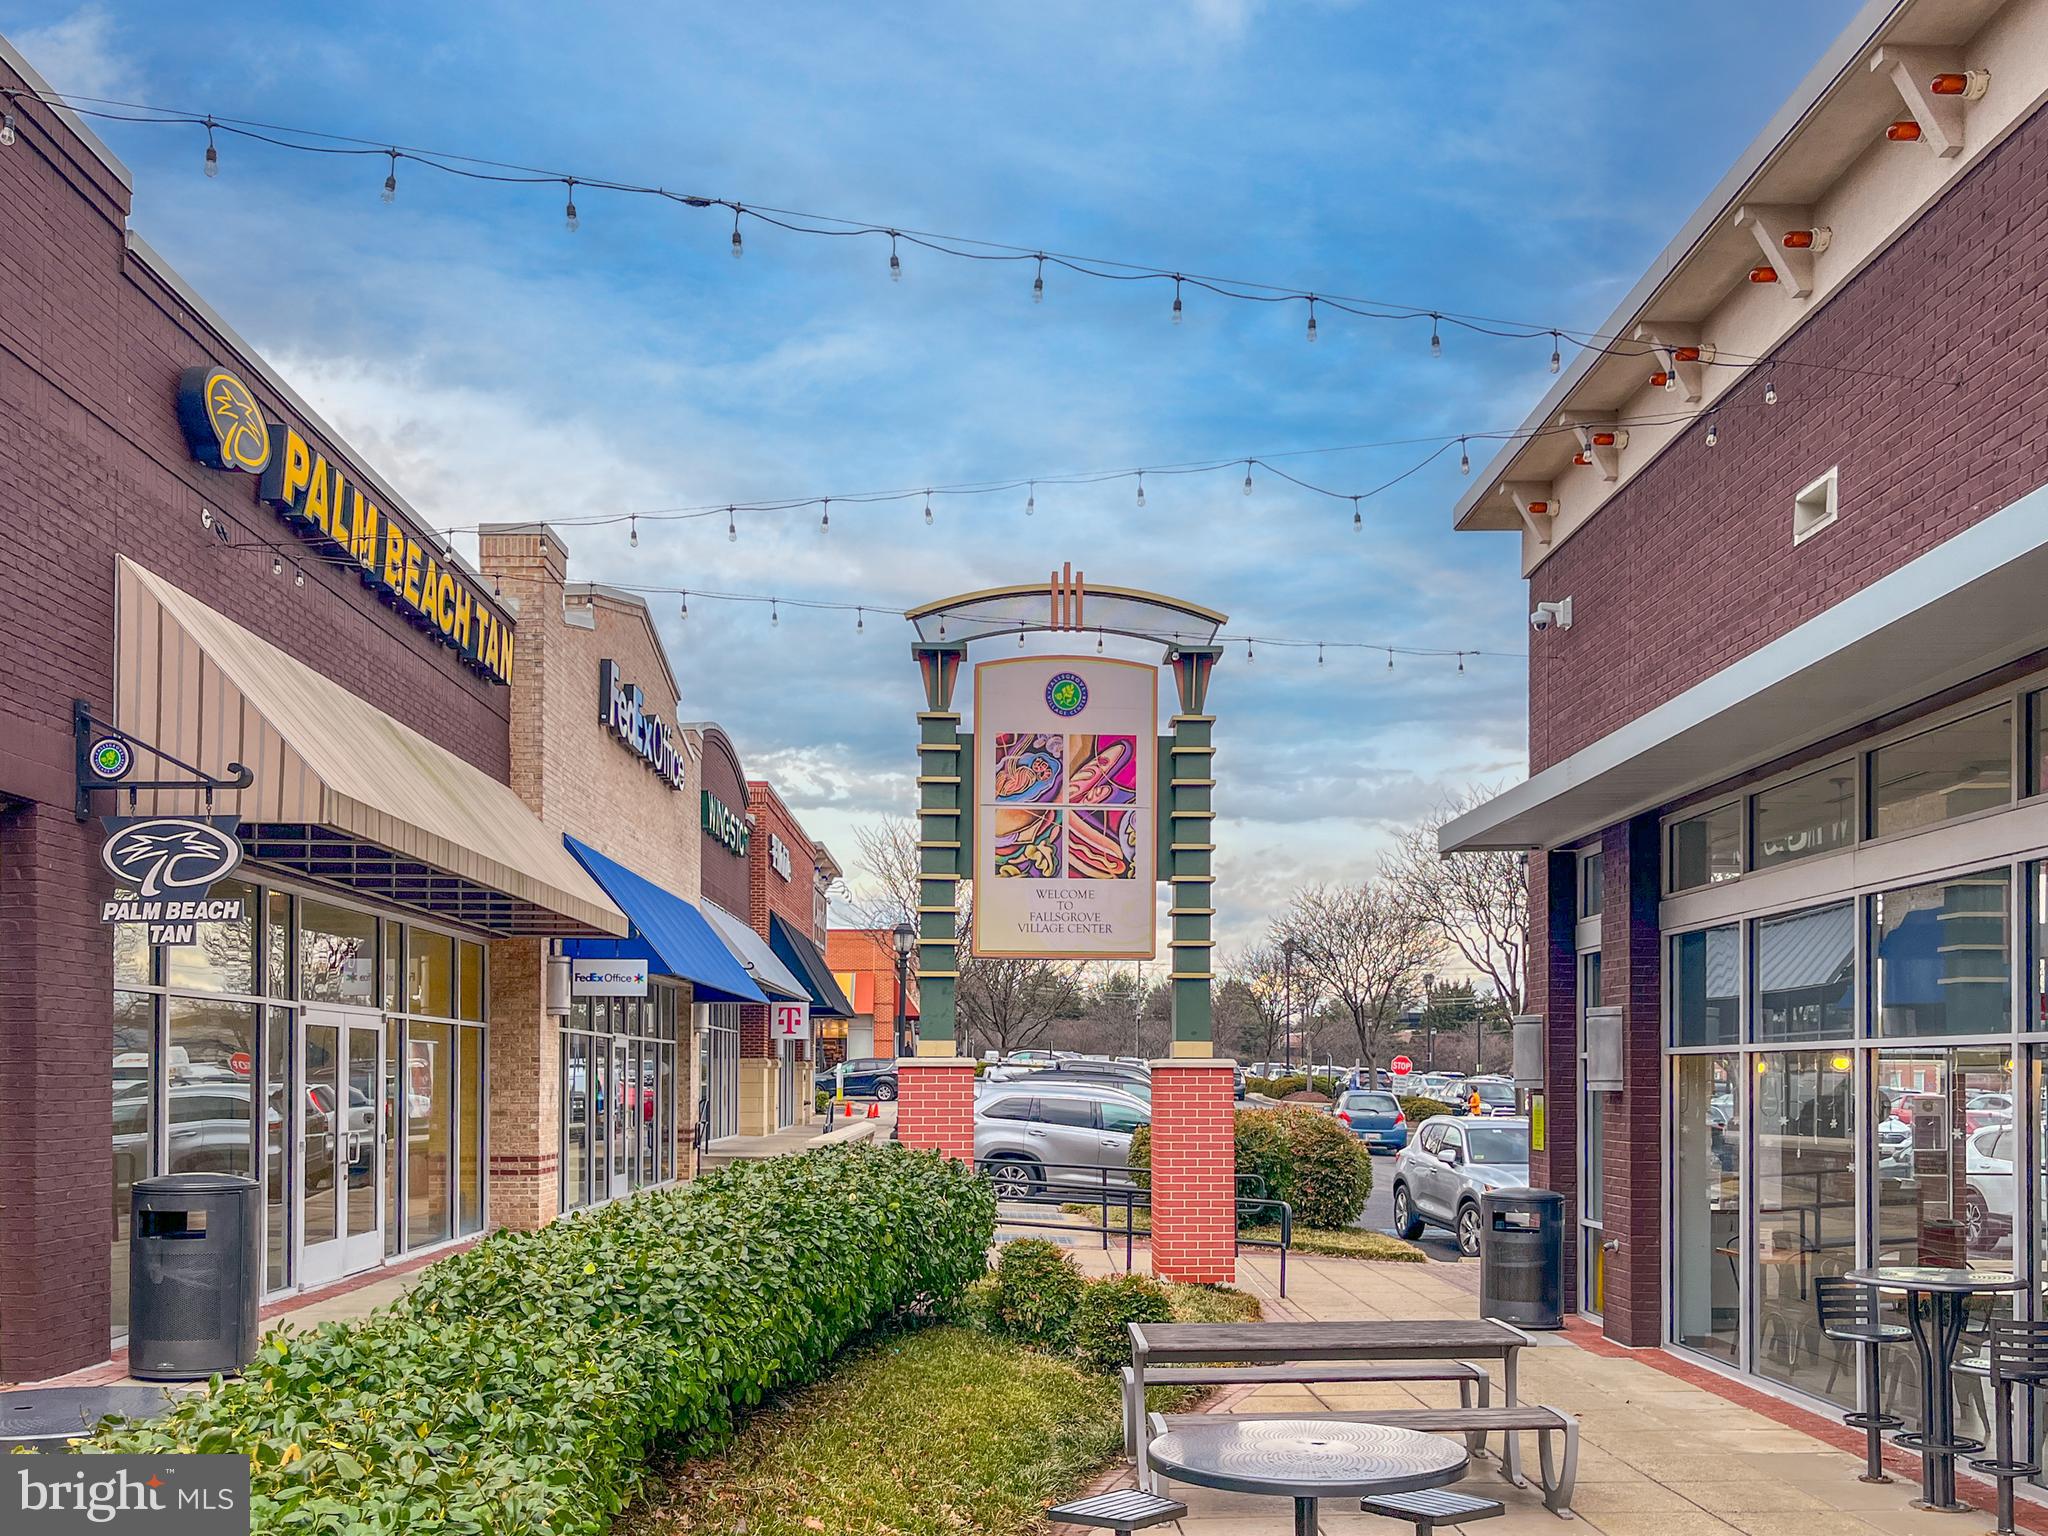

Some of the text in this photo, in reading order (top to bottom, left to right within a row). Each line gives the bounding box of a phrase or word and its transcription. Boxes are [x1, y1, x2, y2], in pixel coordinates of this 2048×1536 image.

[282, 430, 514, 687] PALM BEACH TAN
[610, 660, 685, 792] FedEx Office
[1036, 889, 1096, 899] WELCOME
[102, 901, 240, 921] PALM BEACH
[1057, 901, 1074, 910] TO
[1030, 912, 1101, 922] FALLSGROVE
[150, 924, 194, 944] TAN
[1018, 923, 1113, 934] VILLAGE CENTER
[575, 972, 632, 983] FedEx Office
[778, 1007, 802, 1035] T
[1393, 1061, 1411, 1070] STOP
